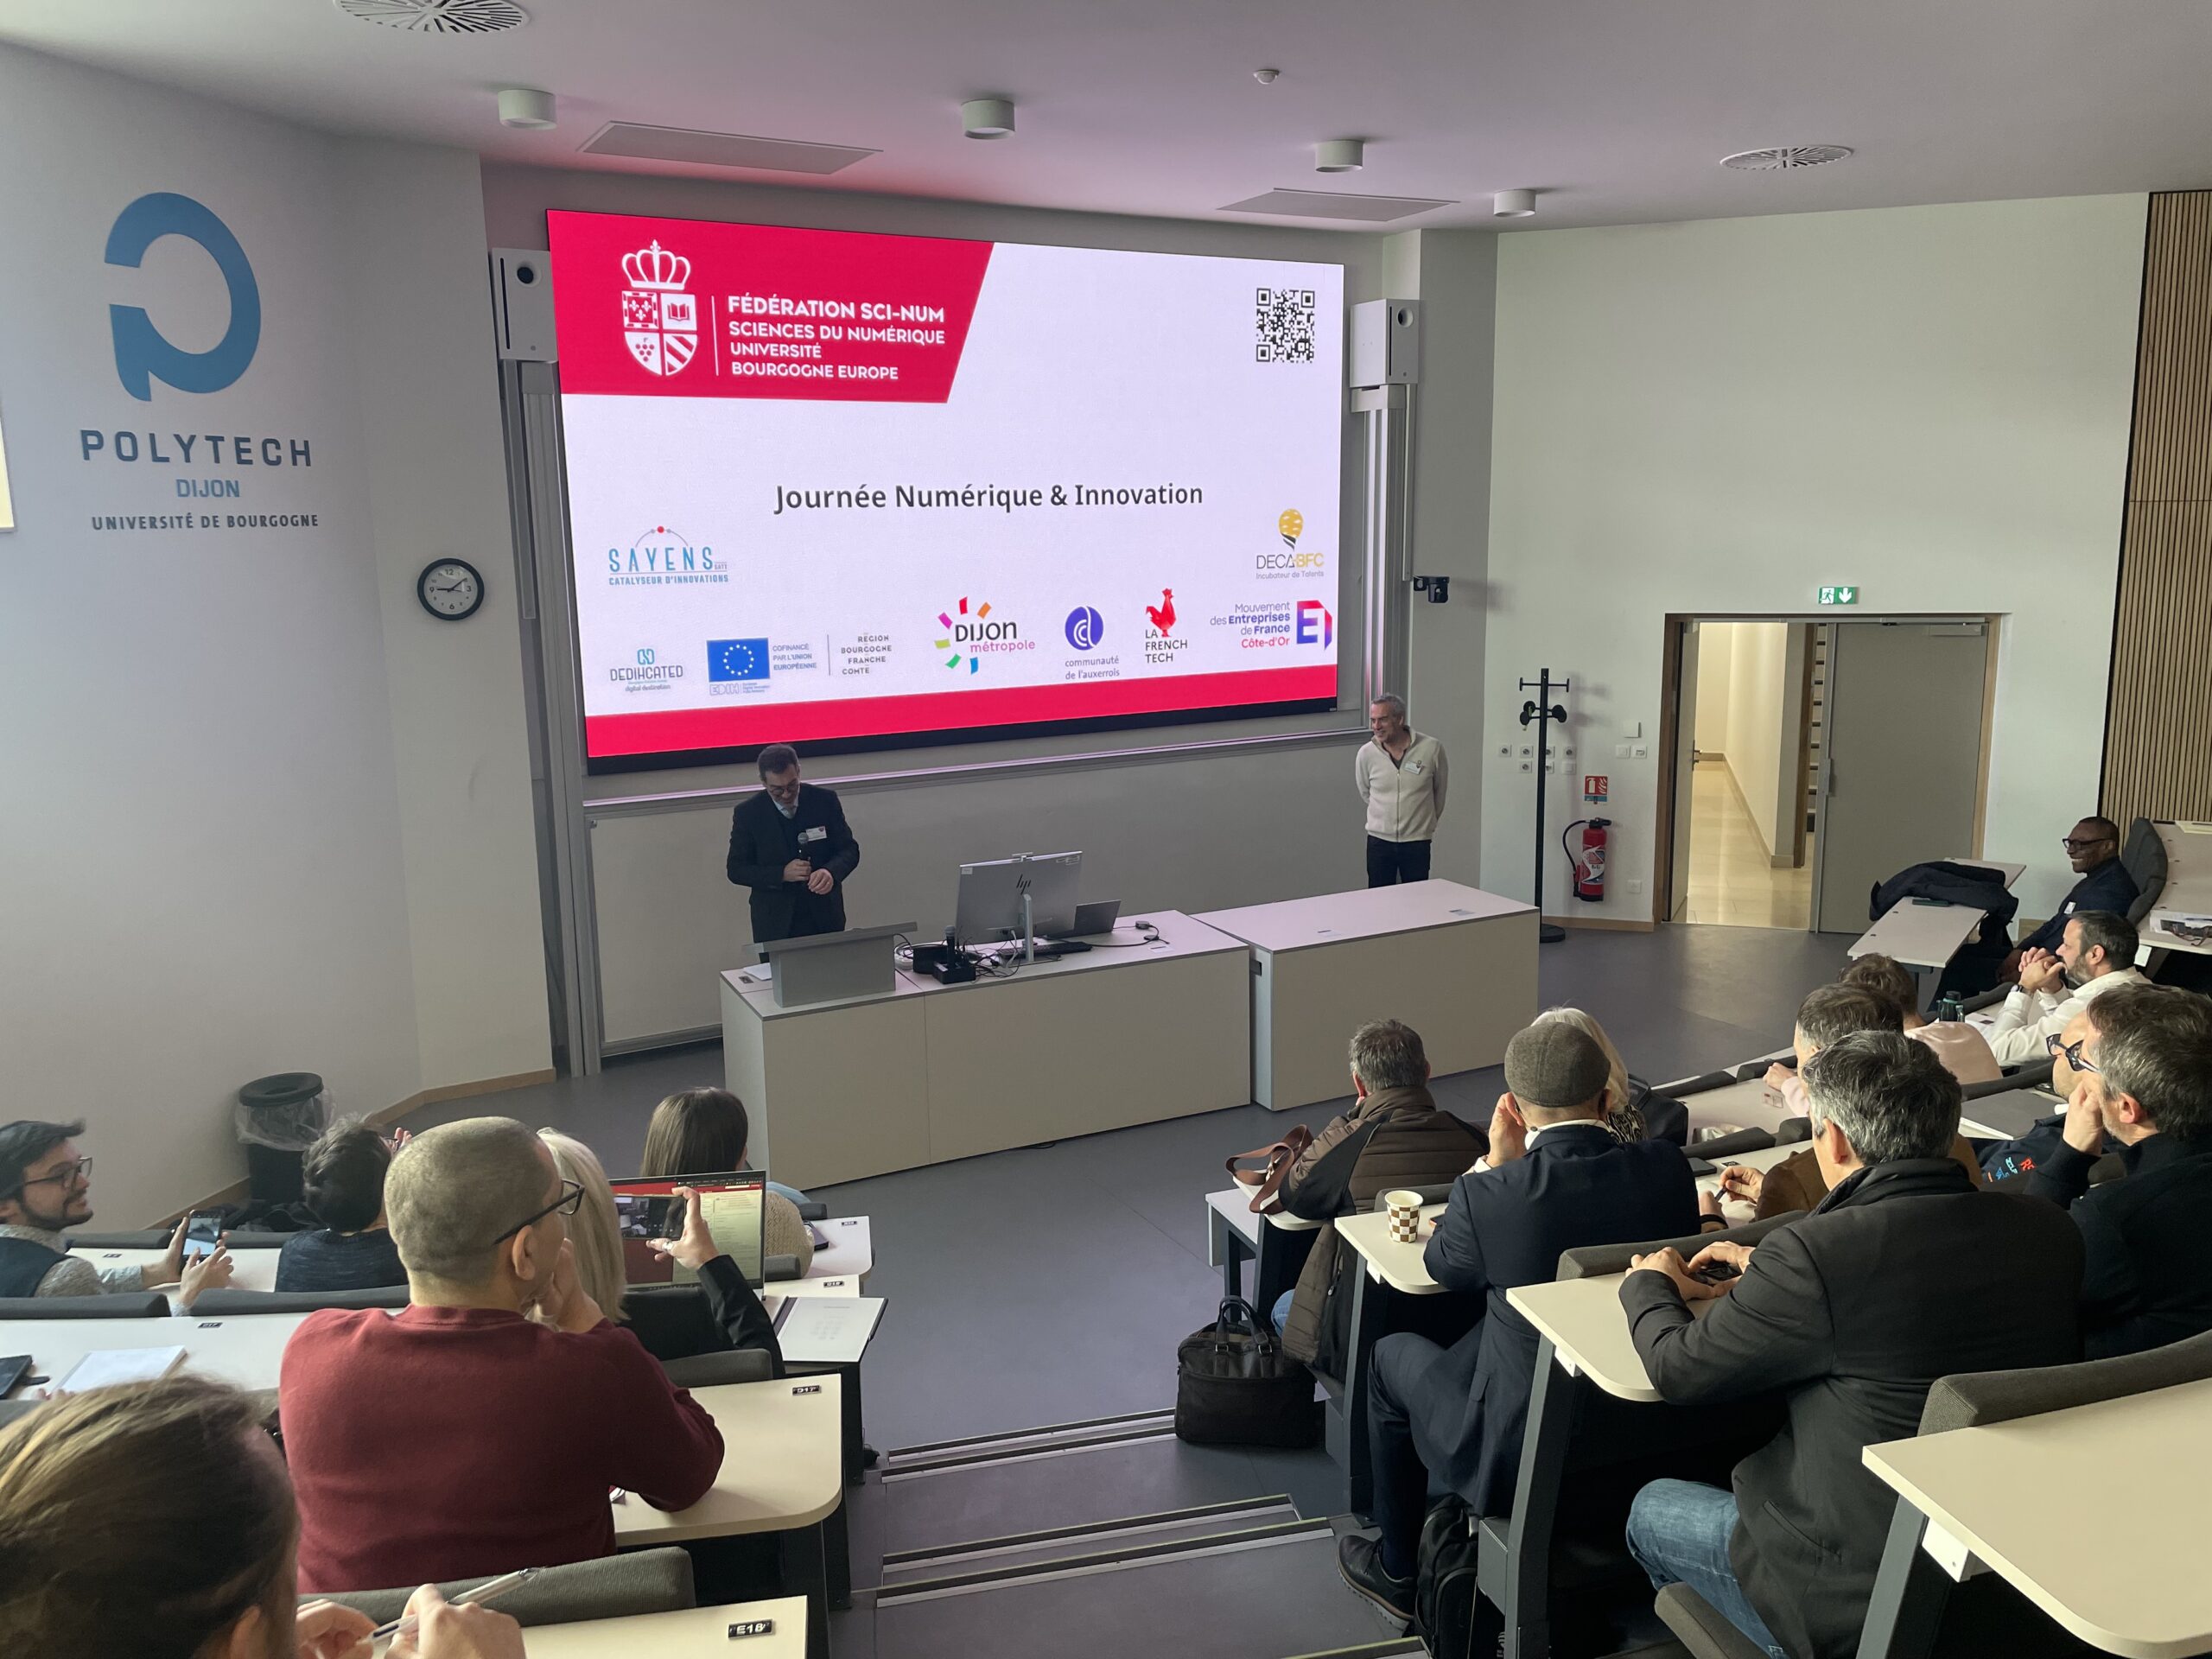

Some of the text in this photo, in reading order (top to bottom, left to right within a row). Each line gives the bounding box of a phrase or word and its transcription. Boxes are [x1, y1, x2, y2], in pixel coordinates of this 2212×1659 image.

[728, 292, 944, 323] FÉDÉRATION SCI-NUM
[728, 321, 945, 346] SCIENCES DU NUMÉRIQUE
[730, 341, 822, 359] UNIVERSITÉ
[732, 361, 899, 379] BOURGOGNE EUROPE
[80, 429, 311, 467] POLYTECH
[175, 479, 240, 498] DIJON
[774, 483, 1204, 515] Journée Numérique & Innovation
[92, 512, 319, 531] UNIVERSITÉ DE BOURGOGNE
[608, 546, 714, 573] SAYENS
[608, 574, 729, 586] CATALYSEUR D'INNOVATIONS
[1235, 601, 1290, 613] Mouvement
[1210, 612, 1290, 626] des Entreprises
[1145, 628, 1159, 639] LA
[1241, 624, 1290, 636] de France
[969, 639, 1035, 652] métropole
[1145, 639, 1188, 651] FRENCH
[1241, 636, 1291, 648] Côte-d'Or
[841, 645, 893, 654] BOURGOGNE
[848, 656, 887, 664] FRANCHE
[1065, 655, 1120, 667] communauté
[1144, 652, 1173, 664] TECH
[610, 665, 683, 681] DEDIHCATED
[1065, 668, 1120, 680] de l'auxerrois
